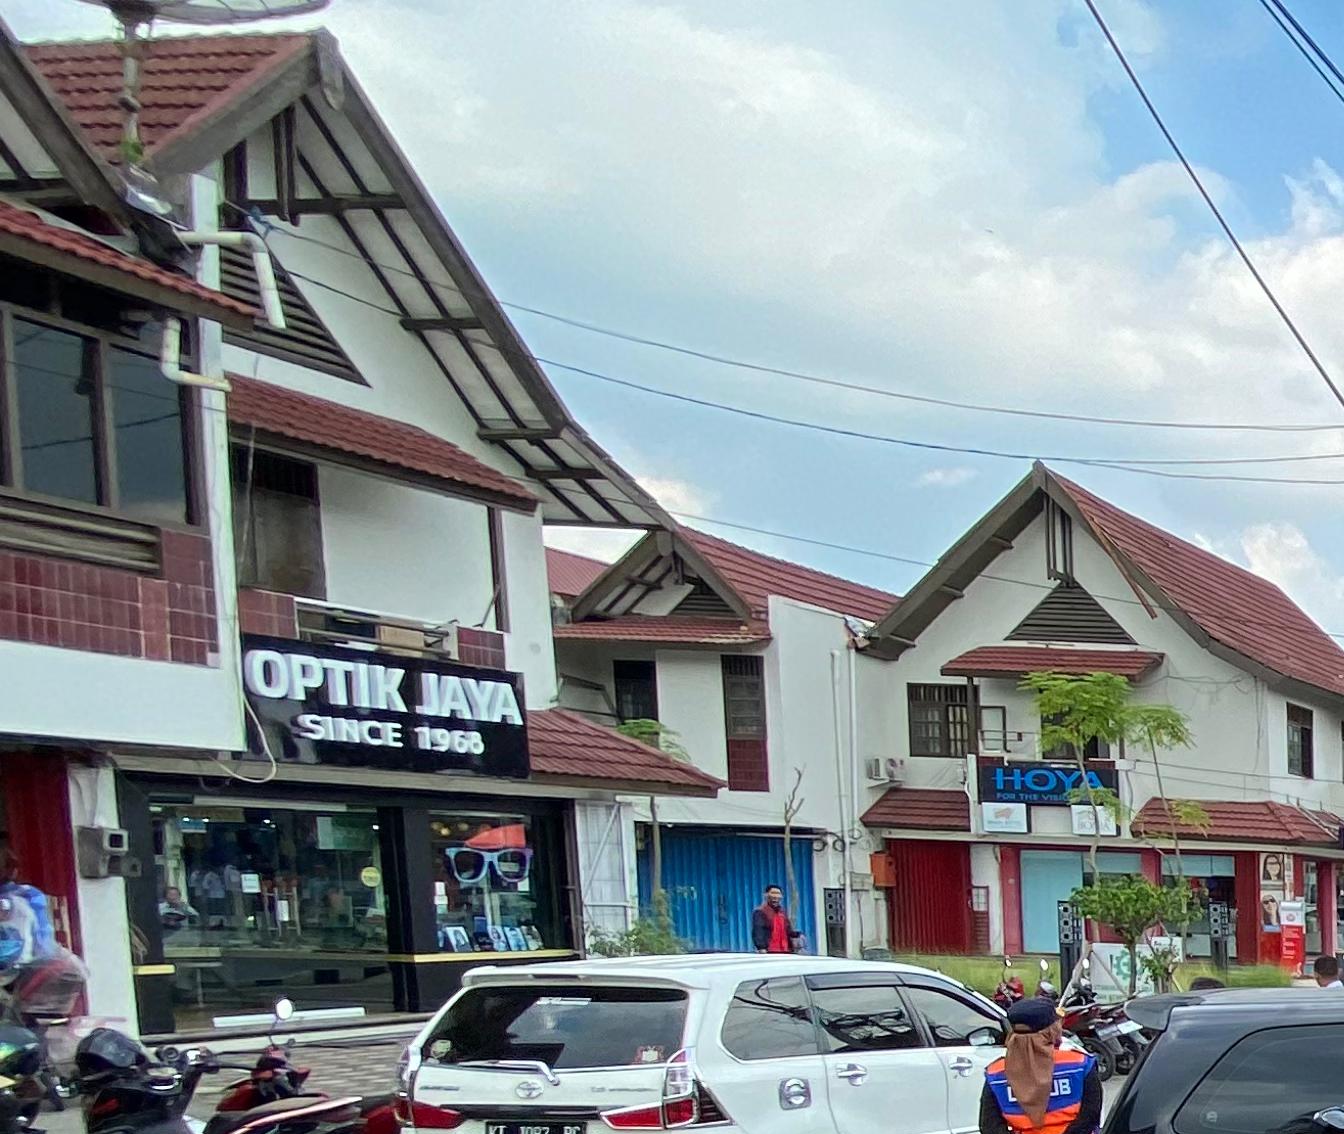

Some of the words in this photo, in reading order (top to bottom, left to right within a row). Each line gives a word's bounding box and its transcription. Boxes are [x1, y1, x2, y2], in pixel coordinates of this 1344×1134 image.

[244, 650, 408, 712] OPTIK
[415, 672, 524, 725] JAYA
[297, 714, 404, 748] SINCE
[414, 727, 485, 755] 1968
[993, 767, 1105, 792] HOYA
[996, 792, 1016, 800] FOR
